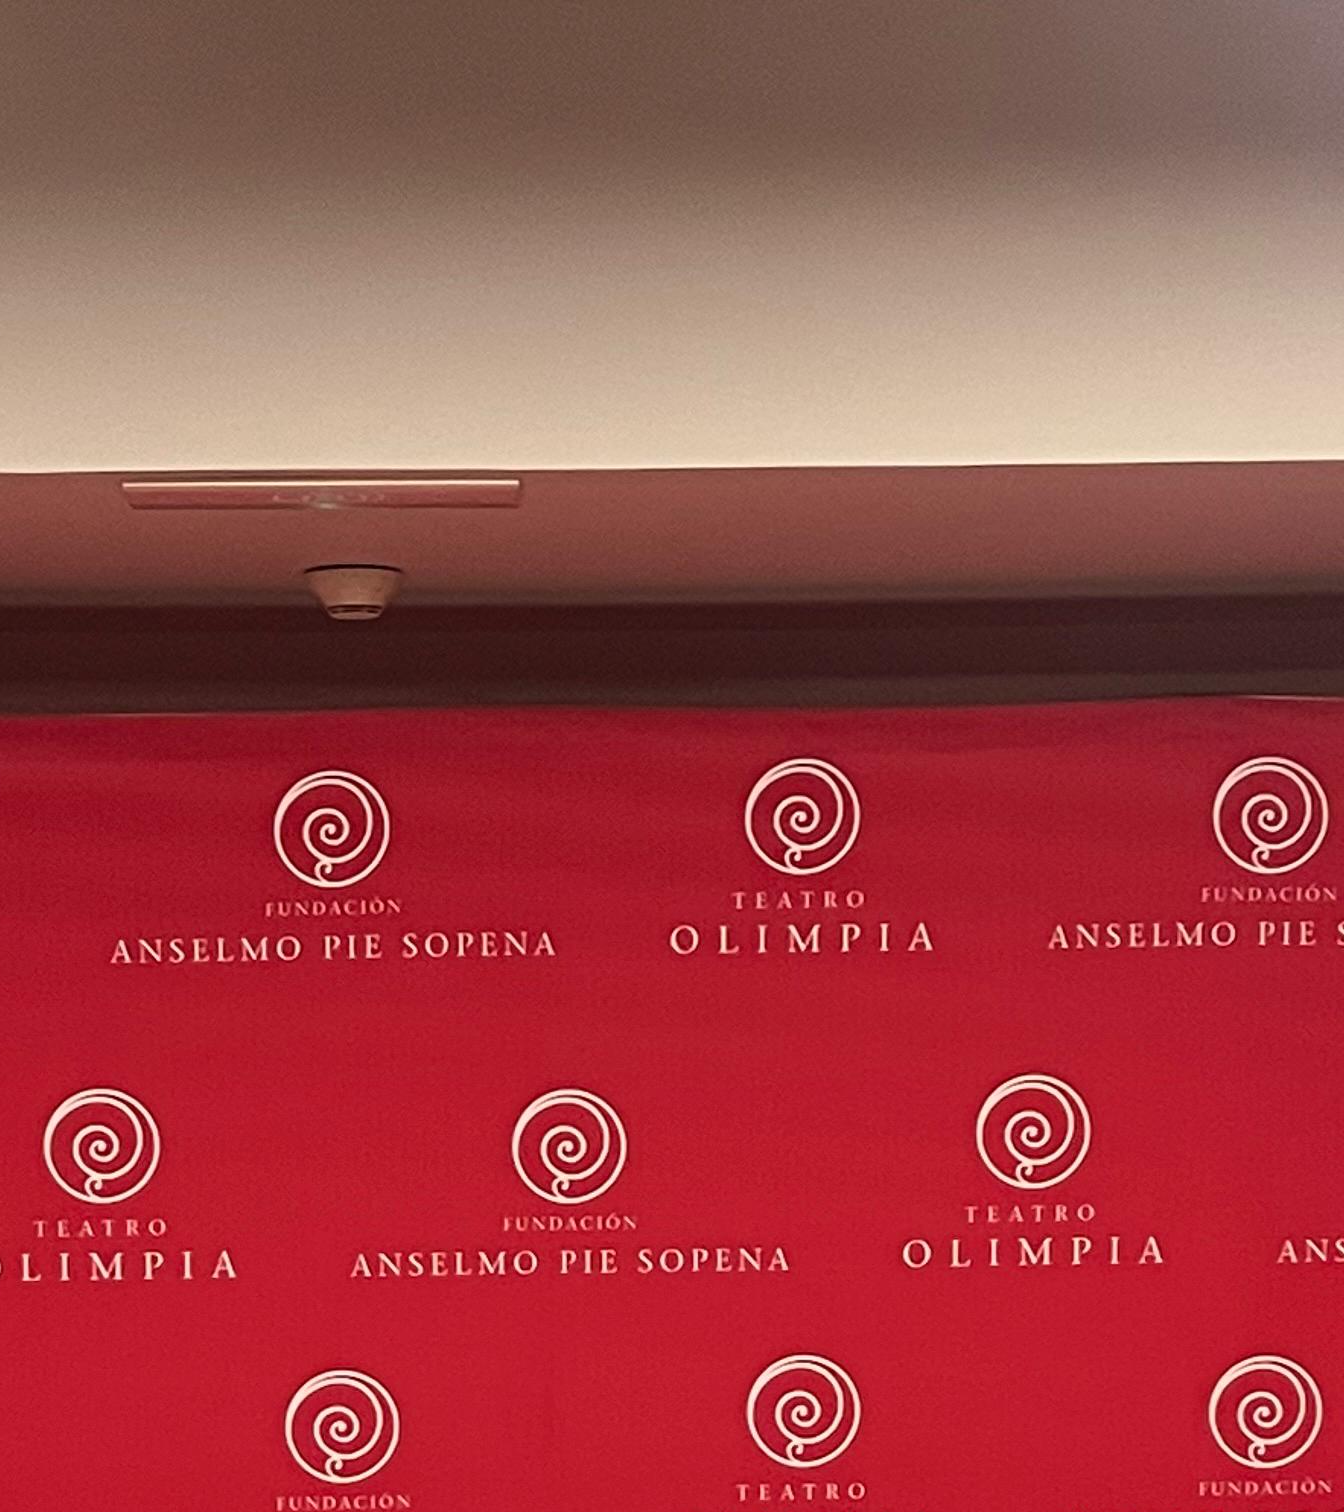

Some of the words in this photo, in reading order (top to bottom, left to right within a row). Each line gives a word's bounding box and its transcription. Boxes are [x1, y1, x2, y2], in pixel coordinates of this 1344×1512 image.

[733, 890, 865, 910] TEATRO
[1201, 884, 1337, 903] FUNDACIÓN
[265, 897, 401, 917] FUNDACIÓN
[669, 922, 933, 955] OLIMPIA
[1048, 921, 1236, 950] ANSELMO
[1258, 920, 1317, 946] PIE
[110, 935, 302, 964] ANSELMO
[324, 933, 383, 961] PIE
[402, 930, 556, 959] SOPENA
[503, 1213, 637, 1232] FUNDACIÓN
[965, 1203, 1096, 1224] TEATRO
[33, 1218, 167, 1238] TEATRO
[902, 1235, 1164, 1269] OLIMPIA
[350, 1250, 538, 1278] ANSELMO
[559, 1249, 618, 1275] PIE
[637, 1247, 789, 1274] SOPENA
[736, 1482, 866, 1502] TEATRO
[1199, 1478, 1332, 1497] FUNDACIÓN
[276, 1493, 411, 1512] FUNDACIÓN
